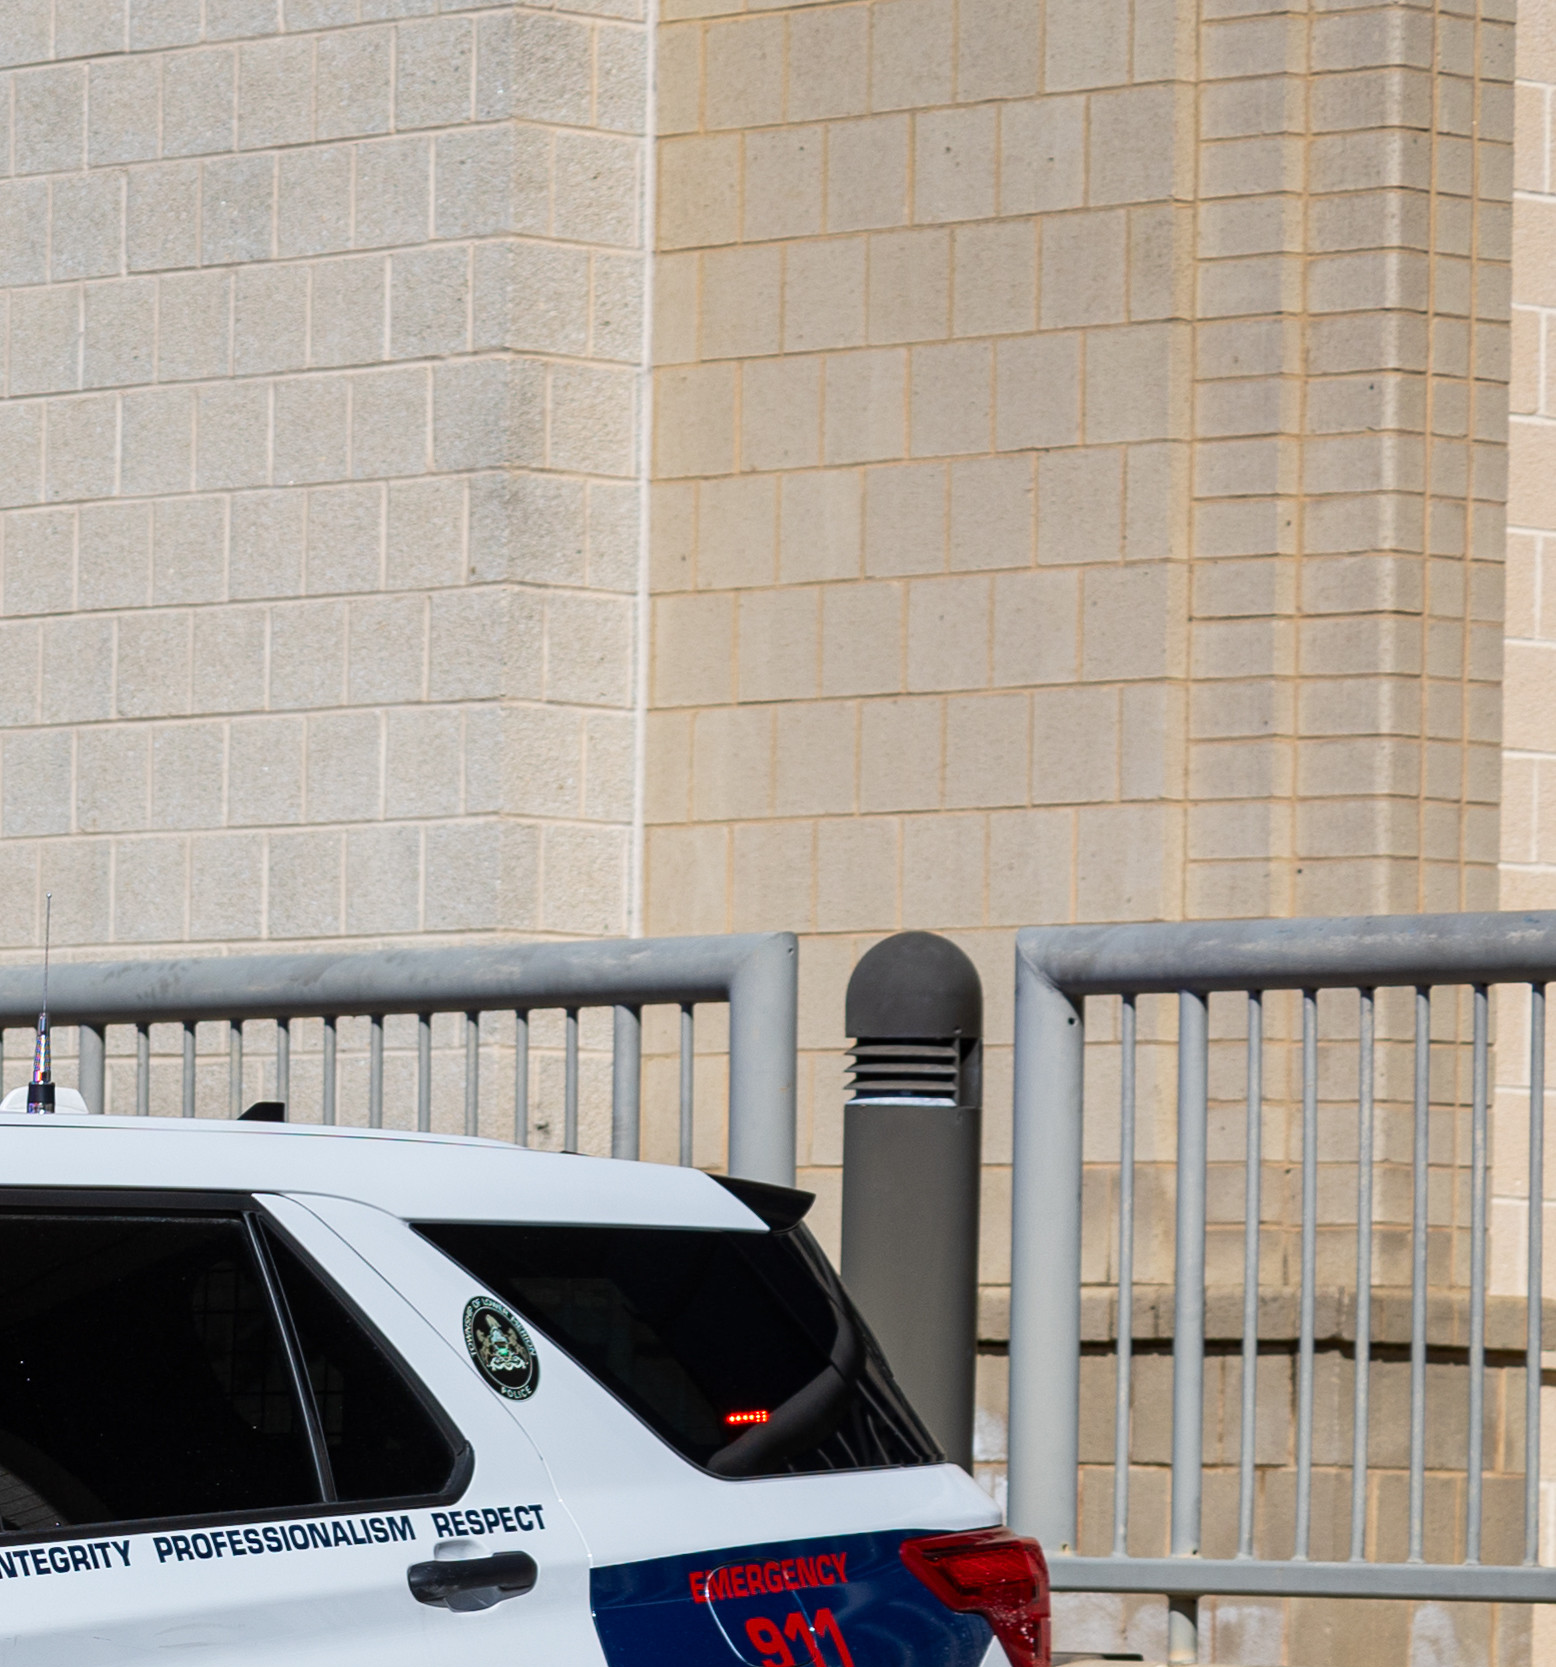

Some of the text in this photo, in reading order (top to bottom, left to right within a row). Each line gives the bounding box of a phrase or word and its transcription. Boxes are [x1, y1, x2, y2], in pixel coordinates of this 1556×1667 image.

[464, 1297, 537, 1357] TOWNSHIP OF LOWER MERION
[500, 1385, 533, 1399] POLICE
[154, 1515, 417, 1564] PROFESSIONALISM
[432, 1503, 547, 1539] RESPECT
[689, 1552, 849, 1604] EMERGENCY
